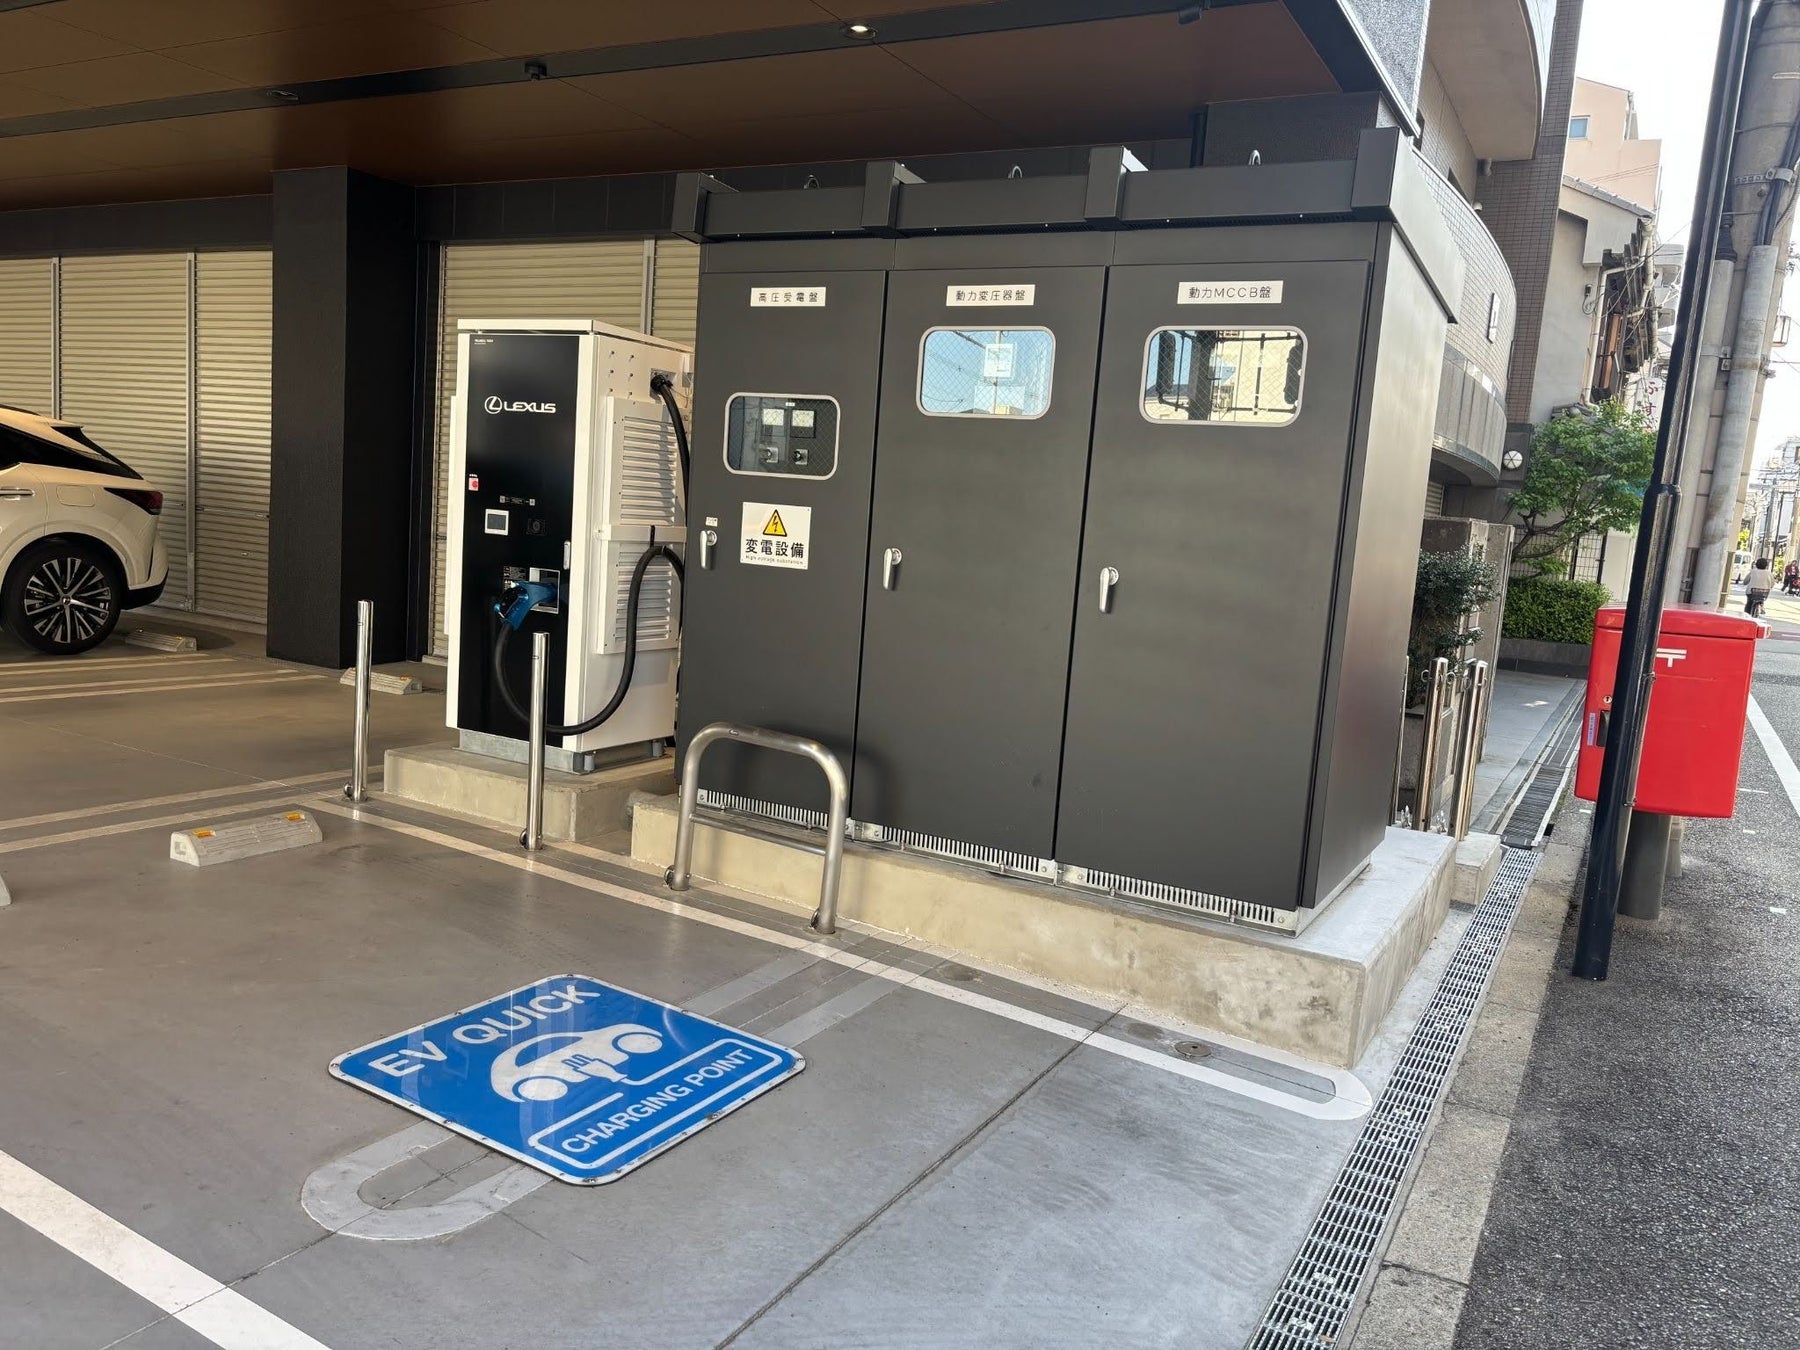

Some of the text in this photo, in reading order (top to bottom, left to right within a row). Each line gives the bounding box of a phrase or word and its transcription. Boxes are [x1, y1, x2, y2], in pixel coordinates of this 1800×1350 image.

[758, 292, 818, 303] 高圧受電盤
[956, 289, 1026, 302] 動力変圧器盤
[1189, 286, 1271, 299] 動力MCCB盤
[503, 401, 556, 413] LEXUS
[745, 538, 804, 558] 変電設備
[367, 984, 602, 1078] EV QUICK
[560, 1048, 755, 1154] CHARGING POINT
